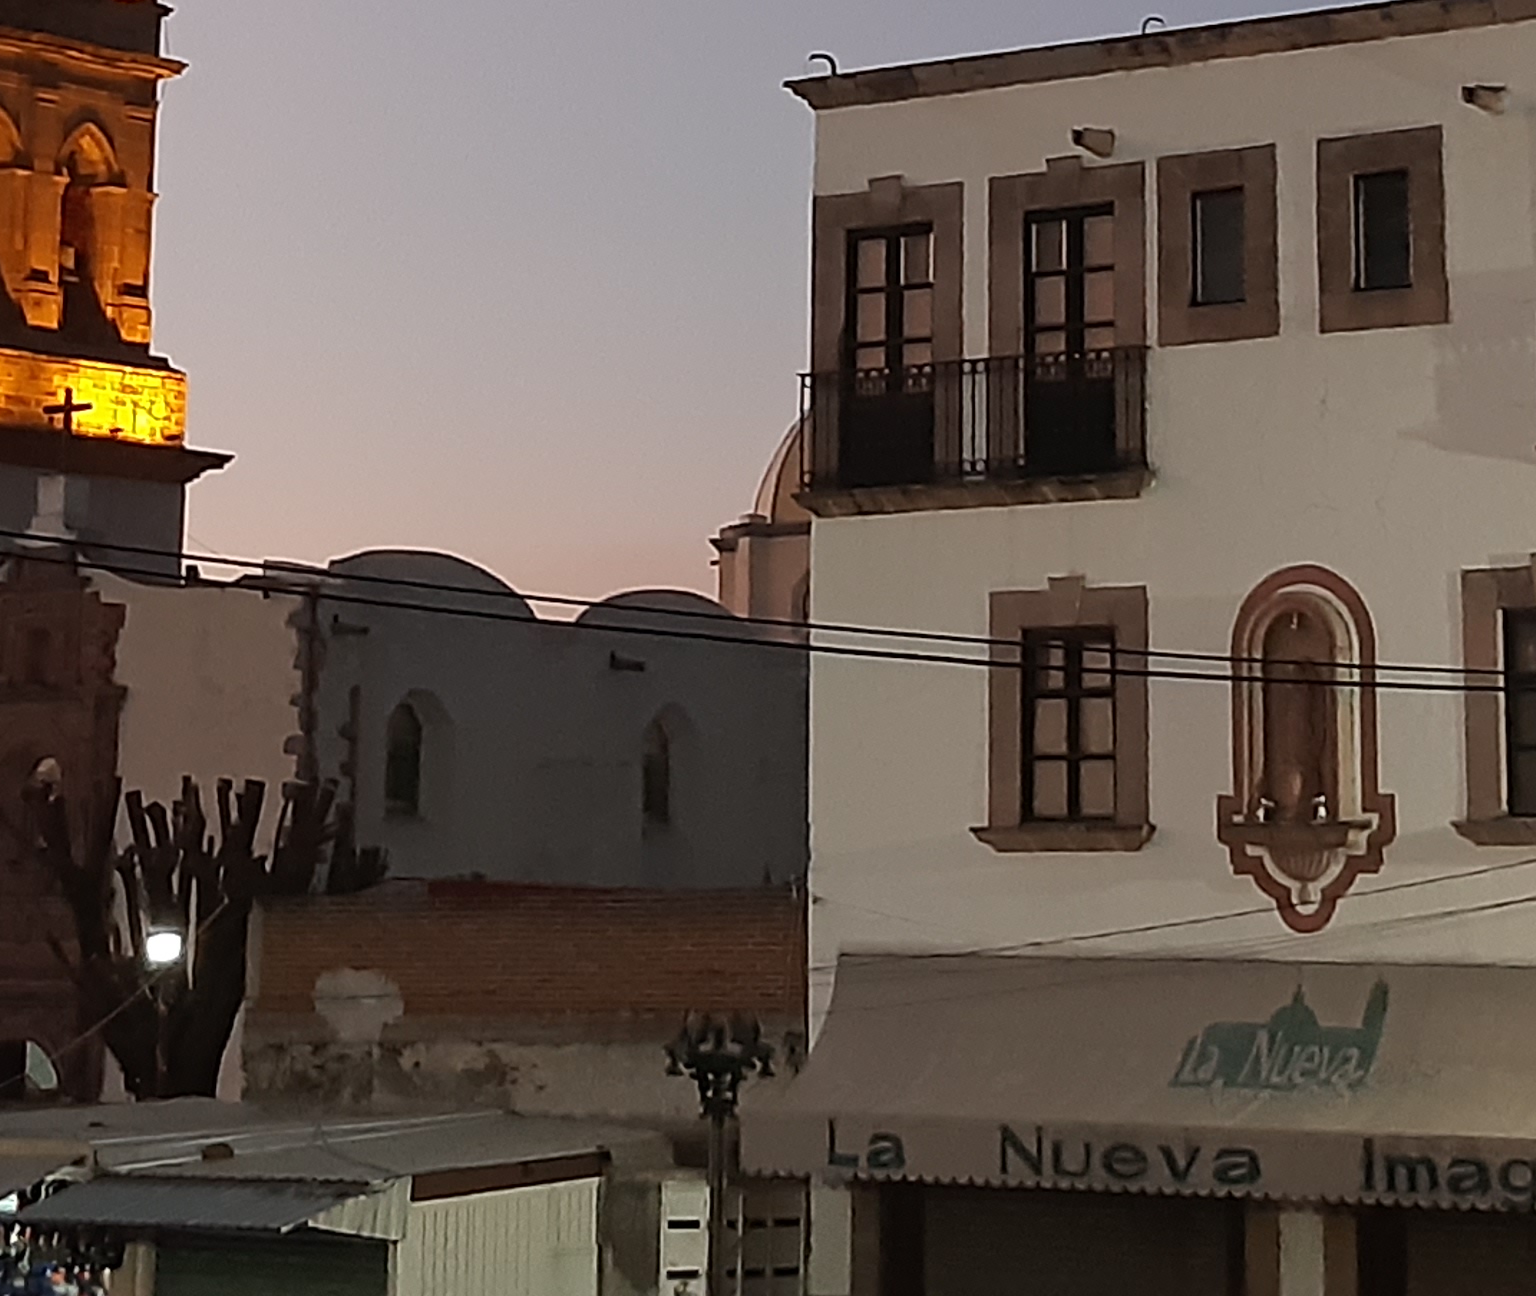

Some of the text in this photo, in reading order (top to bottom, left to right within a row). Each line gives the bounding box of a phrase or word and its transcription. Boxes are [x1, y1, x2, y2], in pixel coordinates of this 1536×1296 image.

[1177, 1029, 1366, 1086] La Nueva
[827, 1117, 907, 1171] La
[998, 1123, 1263, 1186] Nueva
